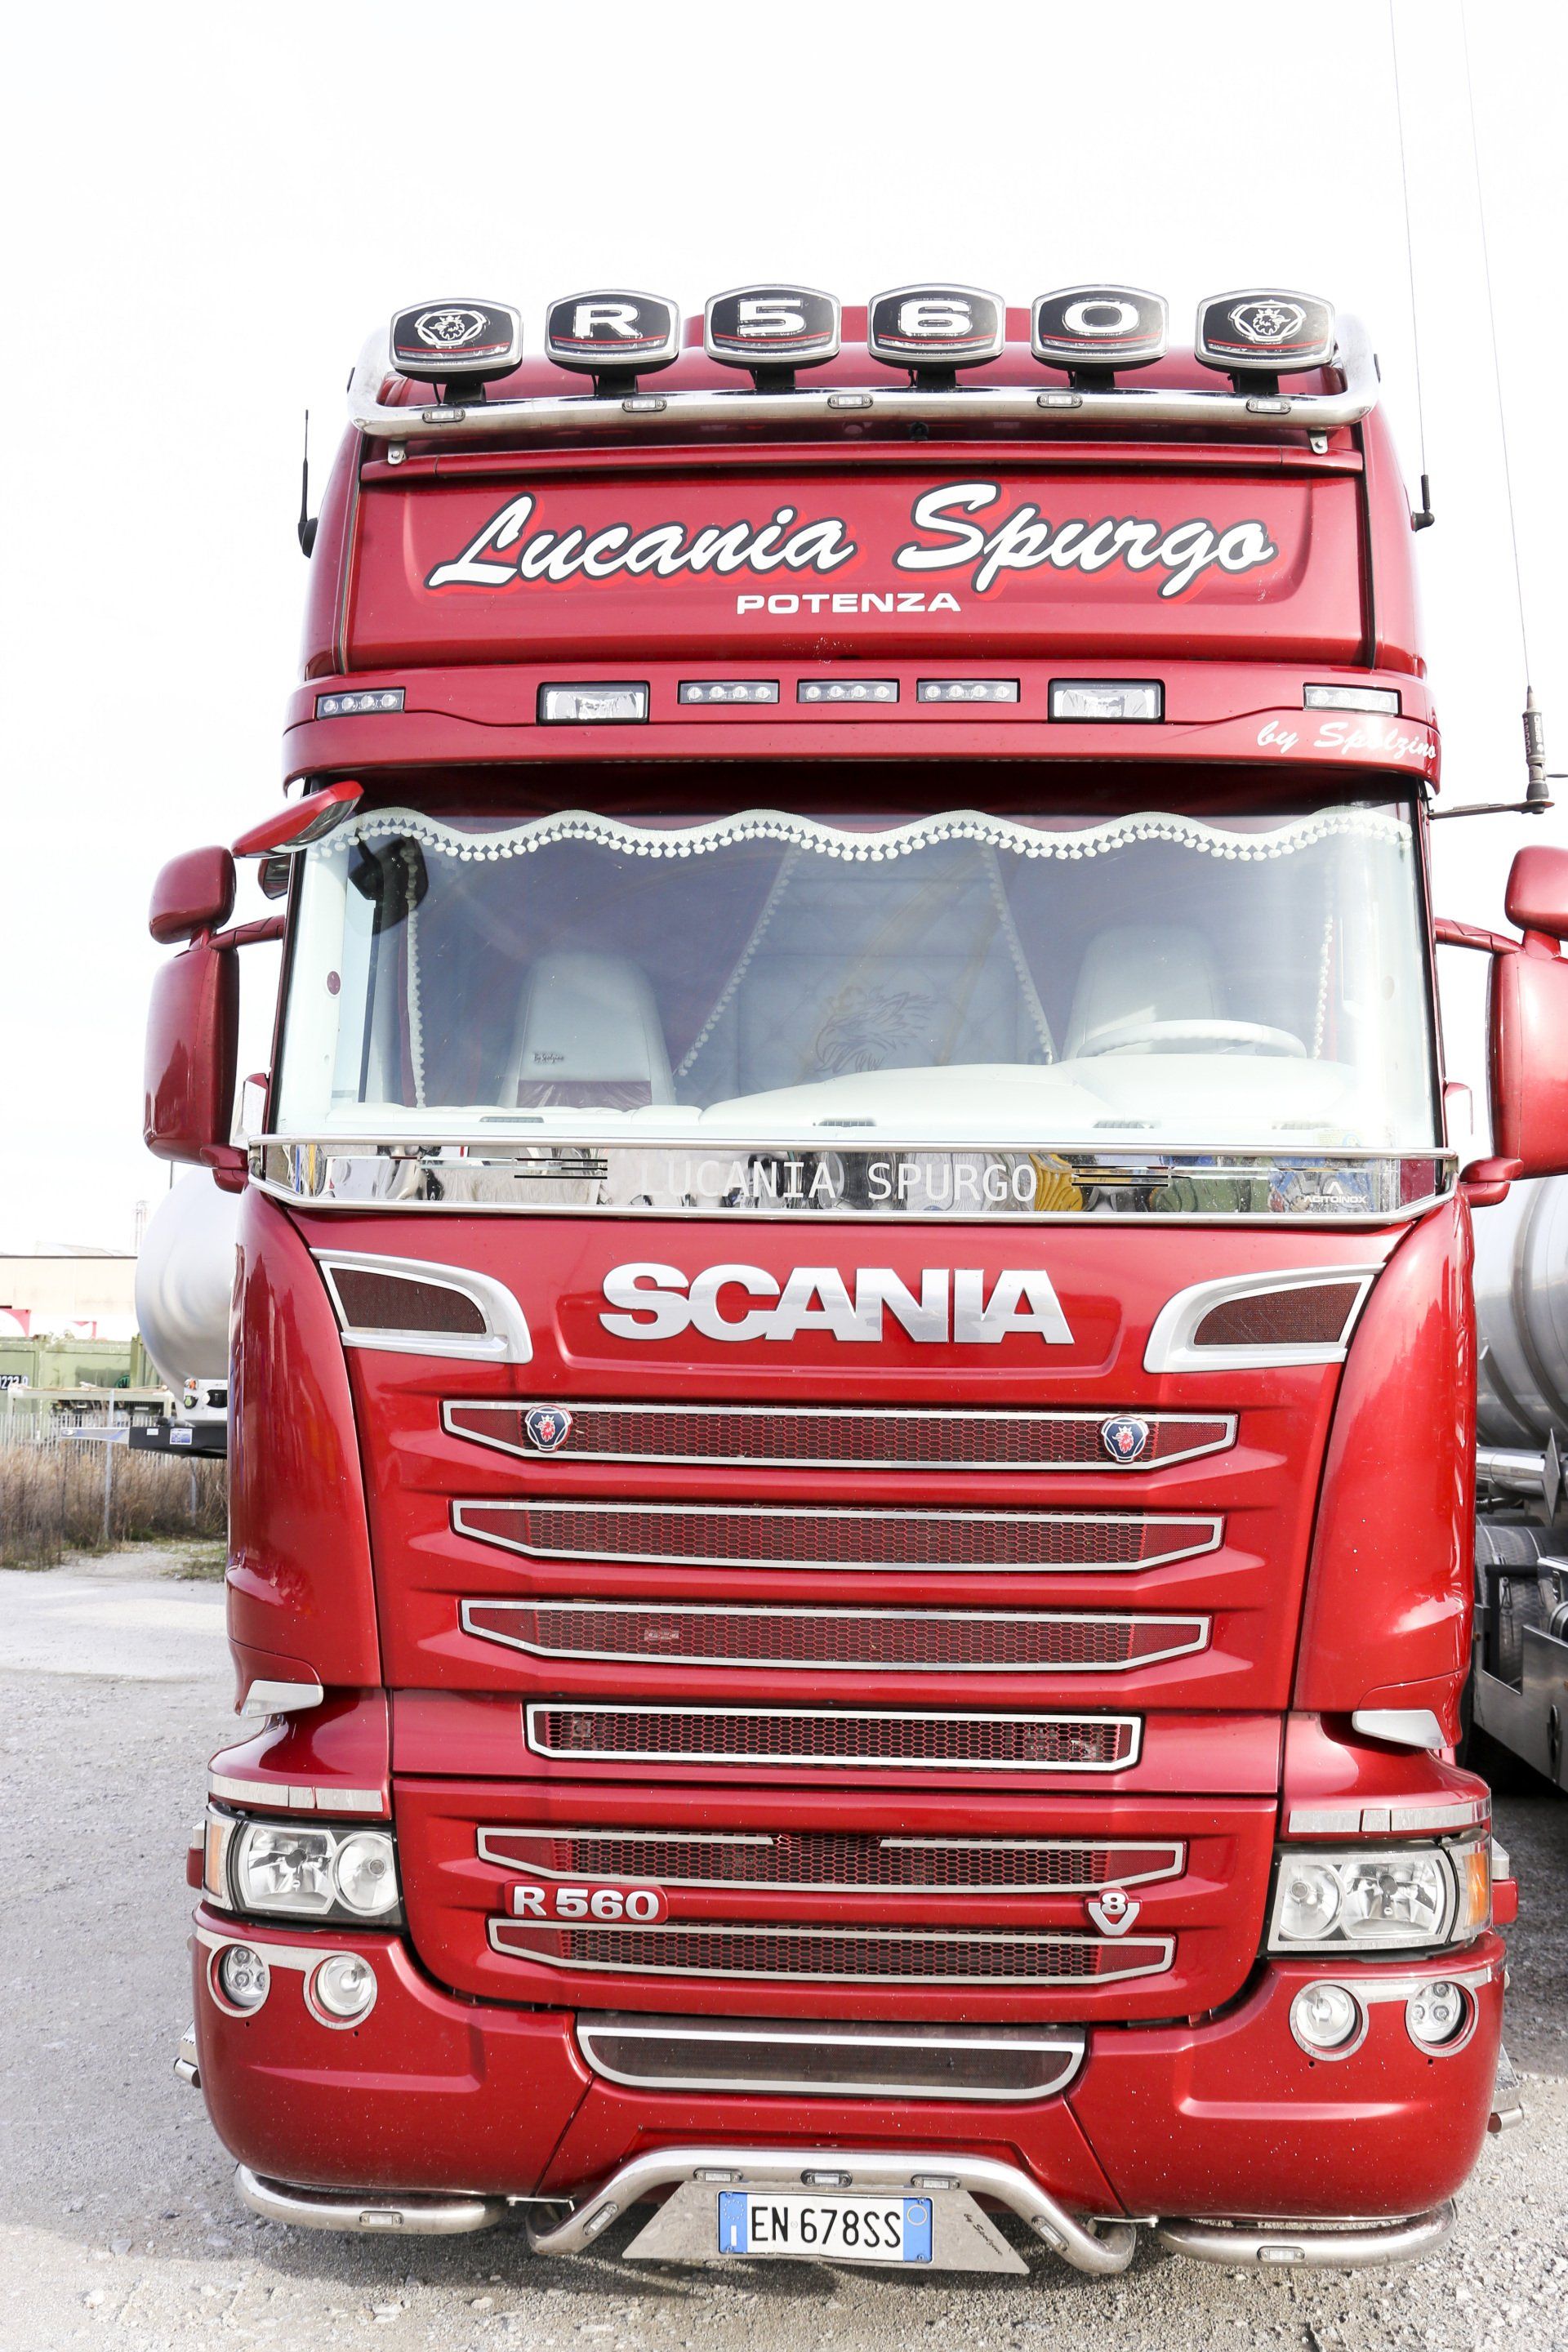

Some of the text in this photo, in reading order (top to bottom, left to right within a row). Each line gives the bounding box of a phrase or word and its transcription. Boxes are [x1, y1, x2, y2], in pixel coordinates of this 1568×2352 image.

[573, 304, 643, 339] R
[737, 299, 805, 336] 5
[898, 299, 973, 336] 6
[424, 480, 1277, 599] Lucania Spurgo
[737, 593, 961, 614] POTENZA
[1257, 720, 1298, 754] by
[641, 1160, 1037, 1202] LUCANIA SPURGO
[599, 1262, 1074, 1345] SCANIA
[513, 1885, 660, 1921] R 560
[751, 2206, 902, 2248] EN 678SS
